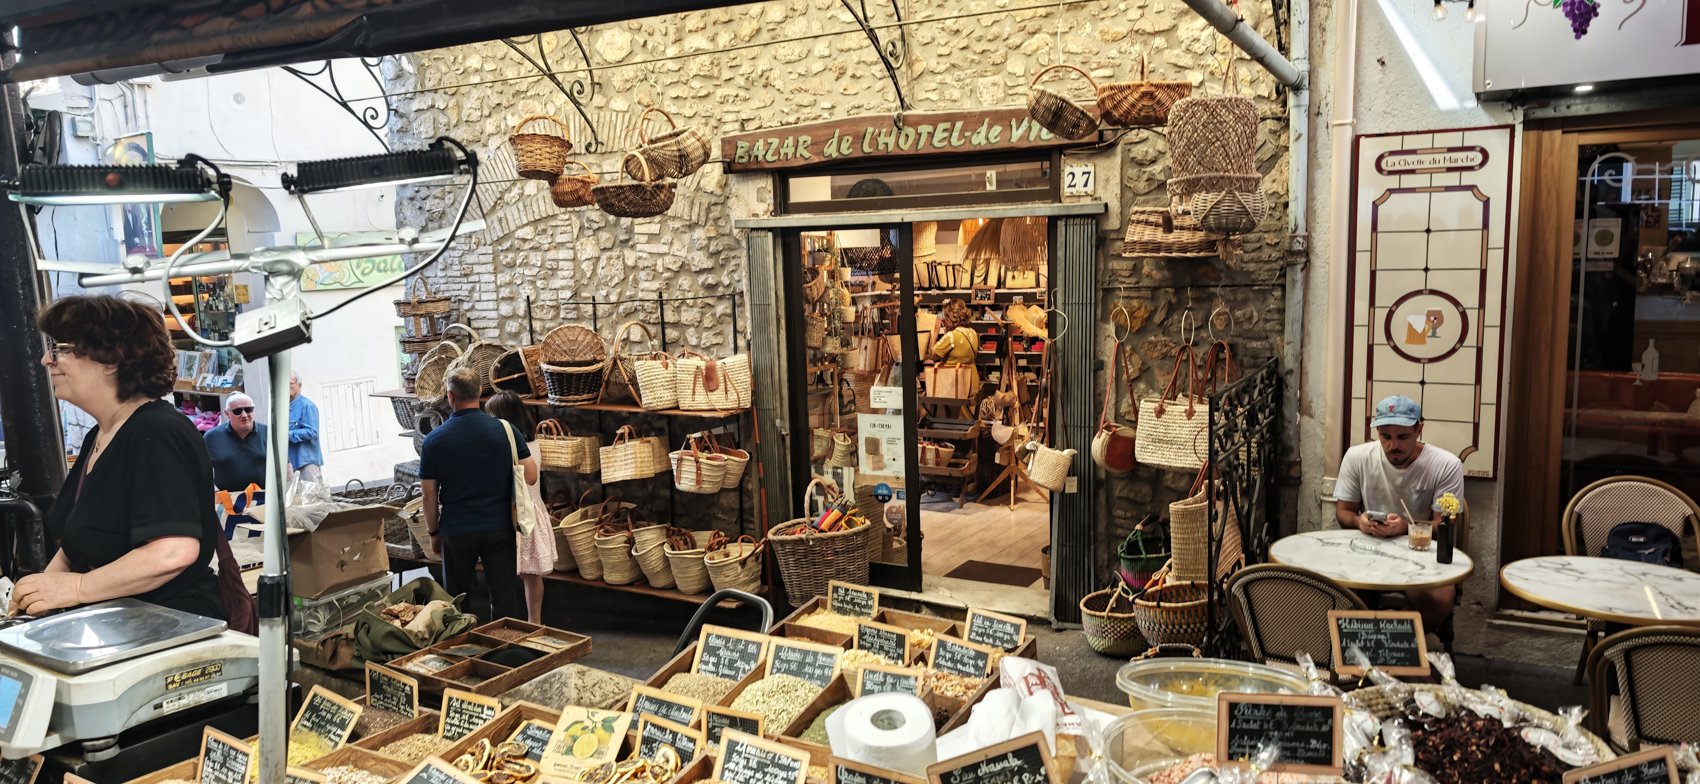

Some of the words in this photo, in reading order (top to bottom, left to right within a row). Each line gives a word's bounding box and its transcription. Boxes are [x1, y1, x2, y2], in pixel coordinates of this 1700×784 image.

[734, 134, 812, 164] BAZAR
[823, 131, 853, 160] de
[1385, 160, 1396, 168] La
[1429, 157, 1441, 166] du
[1443, 155, 1478, 165] Marché
[1066, 171, 1093, 190] 27
